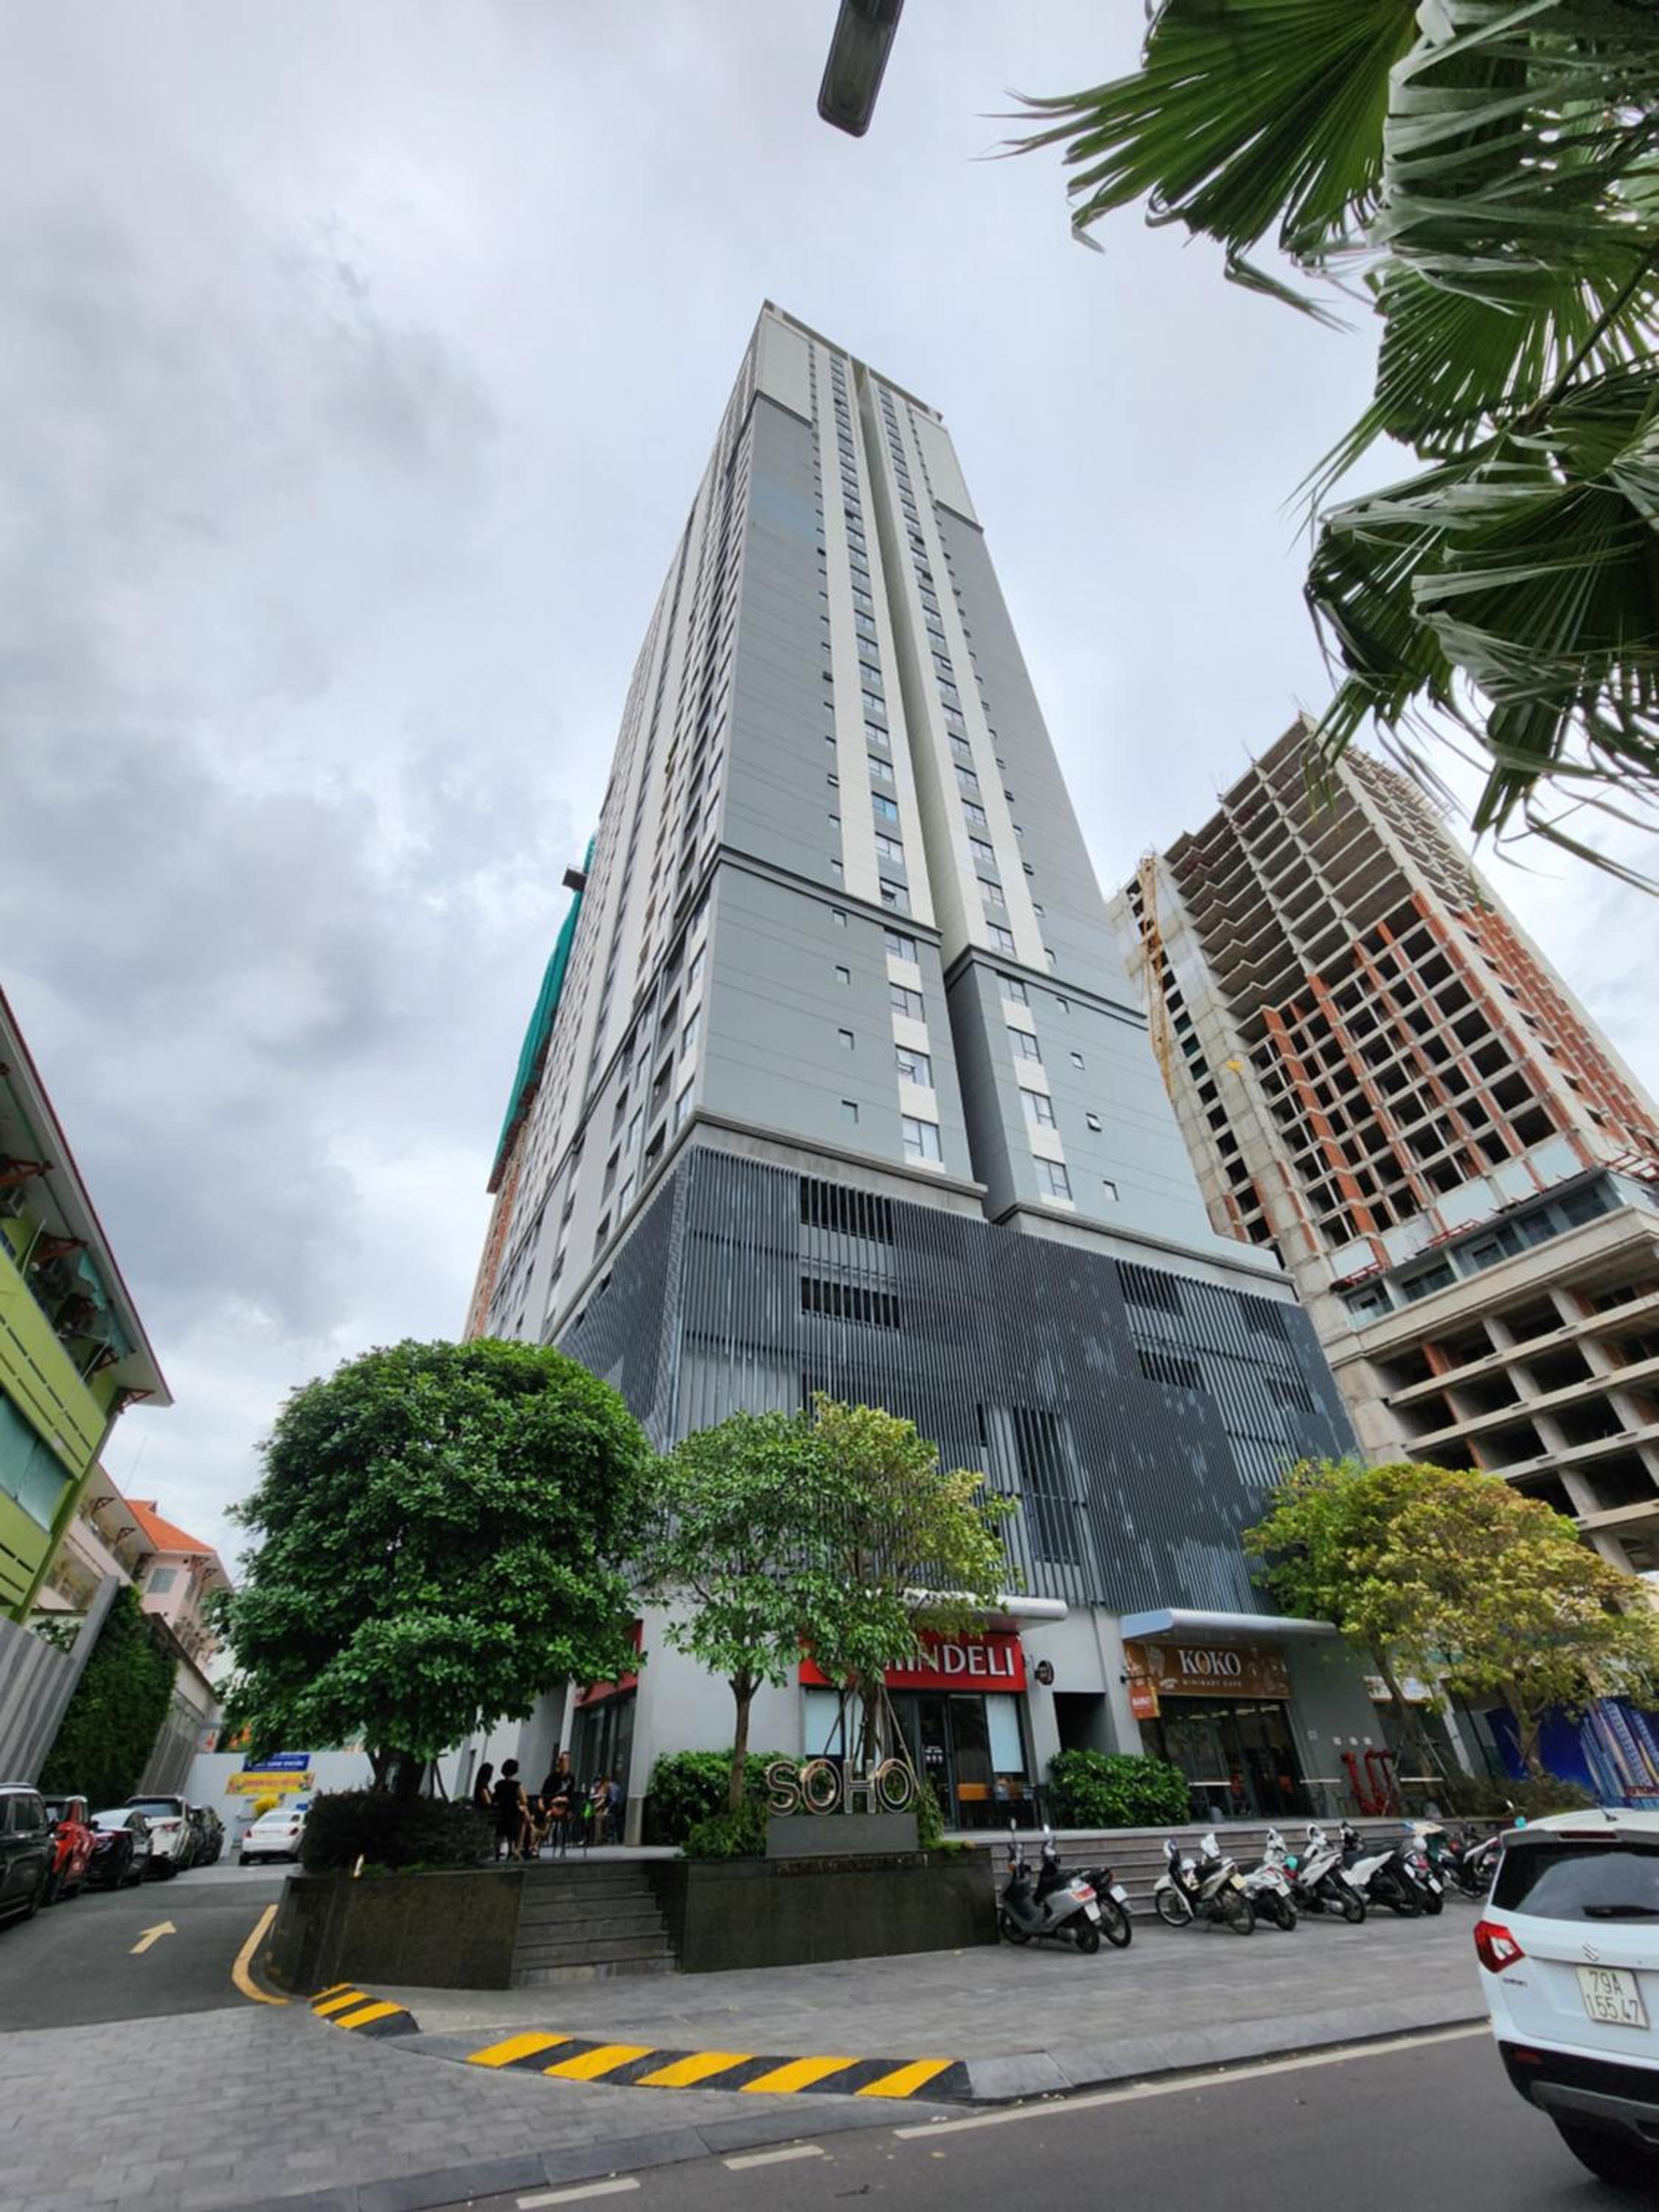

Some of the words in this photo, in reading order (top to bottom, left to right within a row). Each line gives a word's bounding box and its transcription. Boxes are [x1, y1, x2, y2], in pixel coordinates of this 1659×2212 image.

[1178, 1649, 1242, 1675] KOKO
[766, 1758, 914, 1817] SOHO
[1588, 1970, 1623, 1994] 79A
